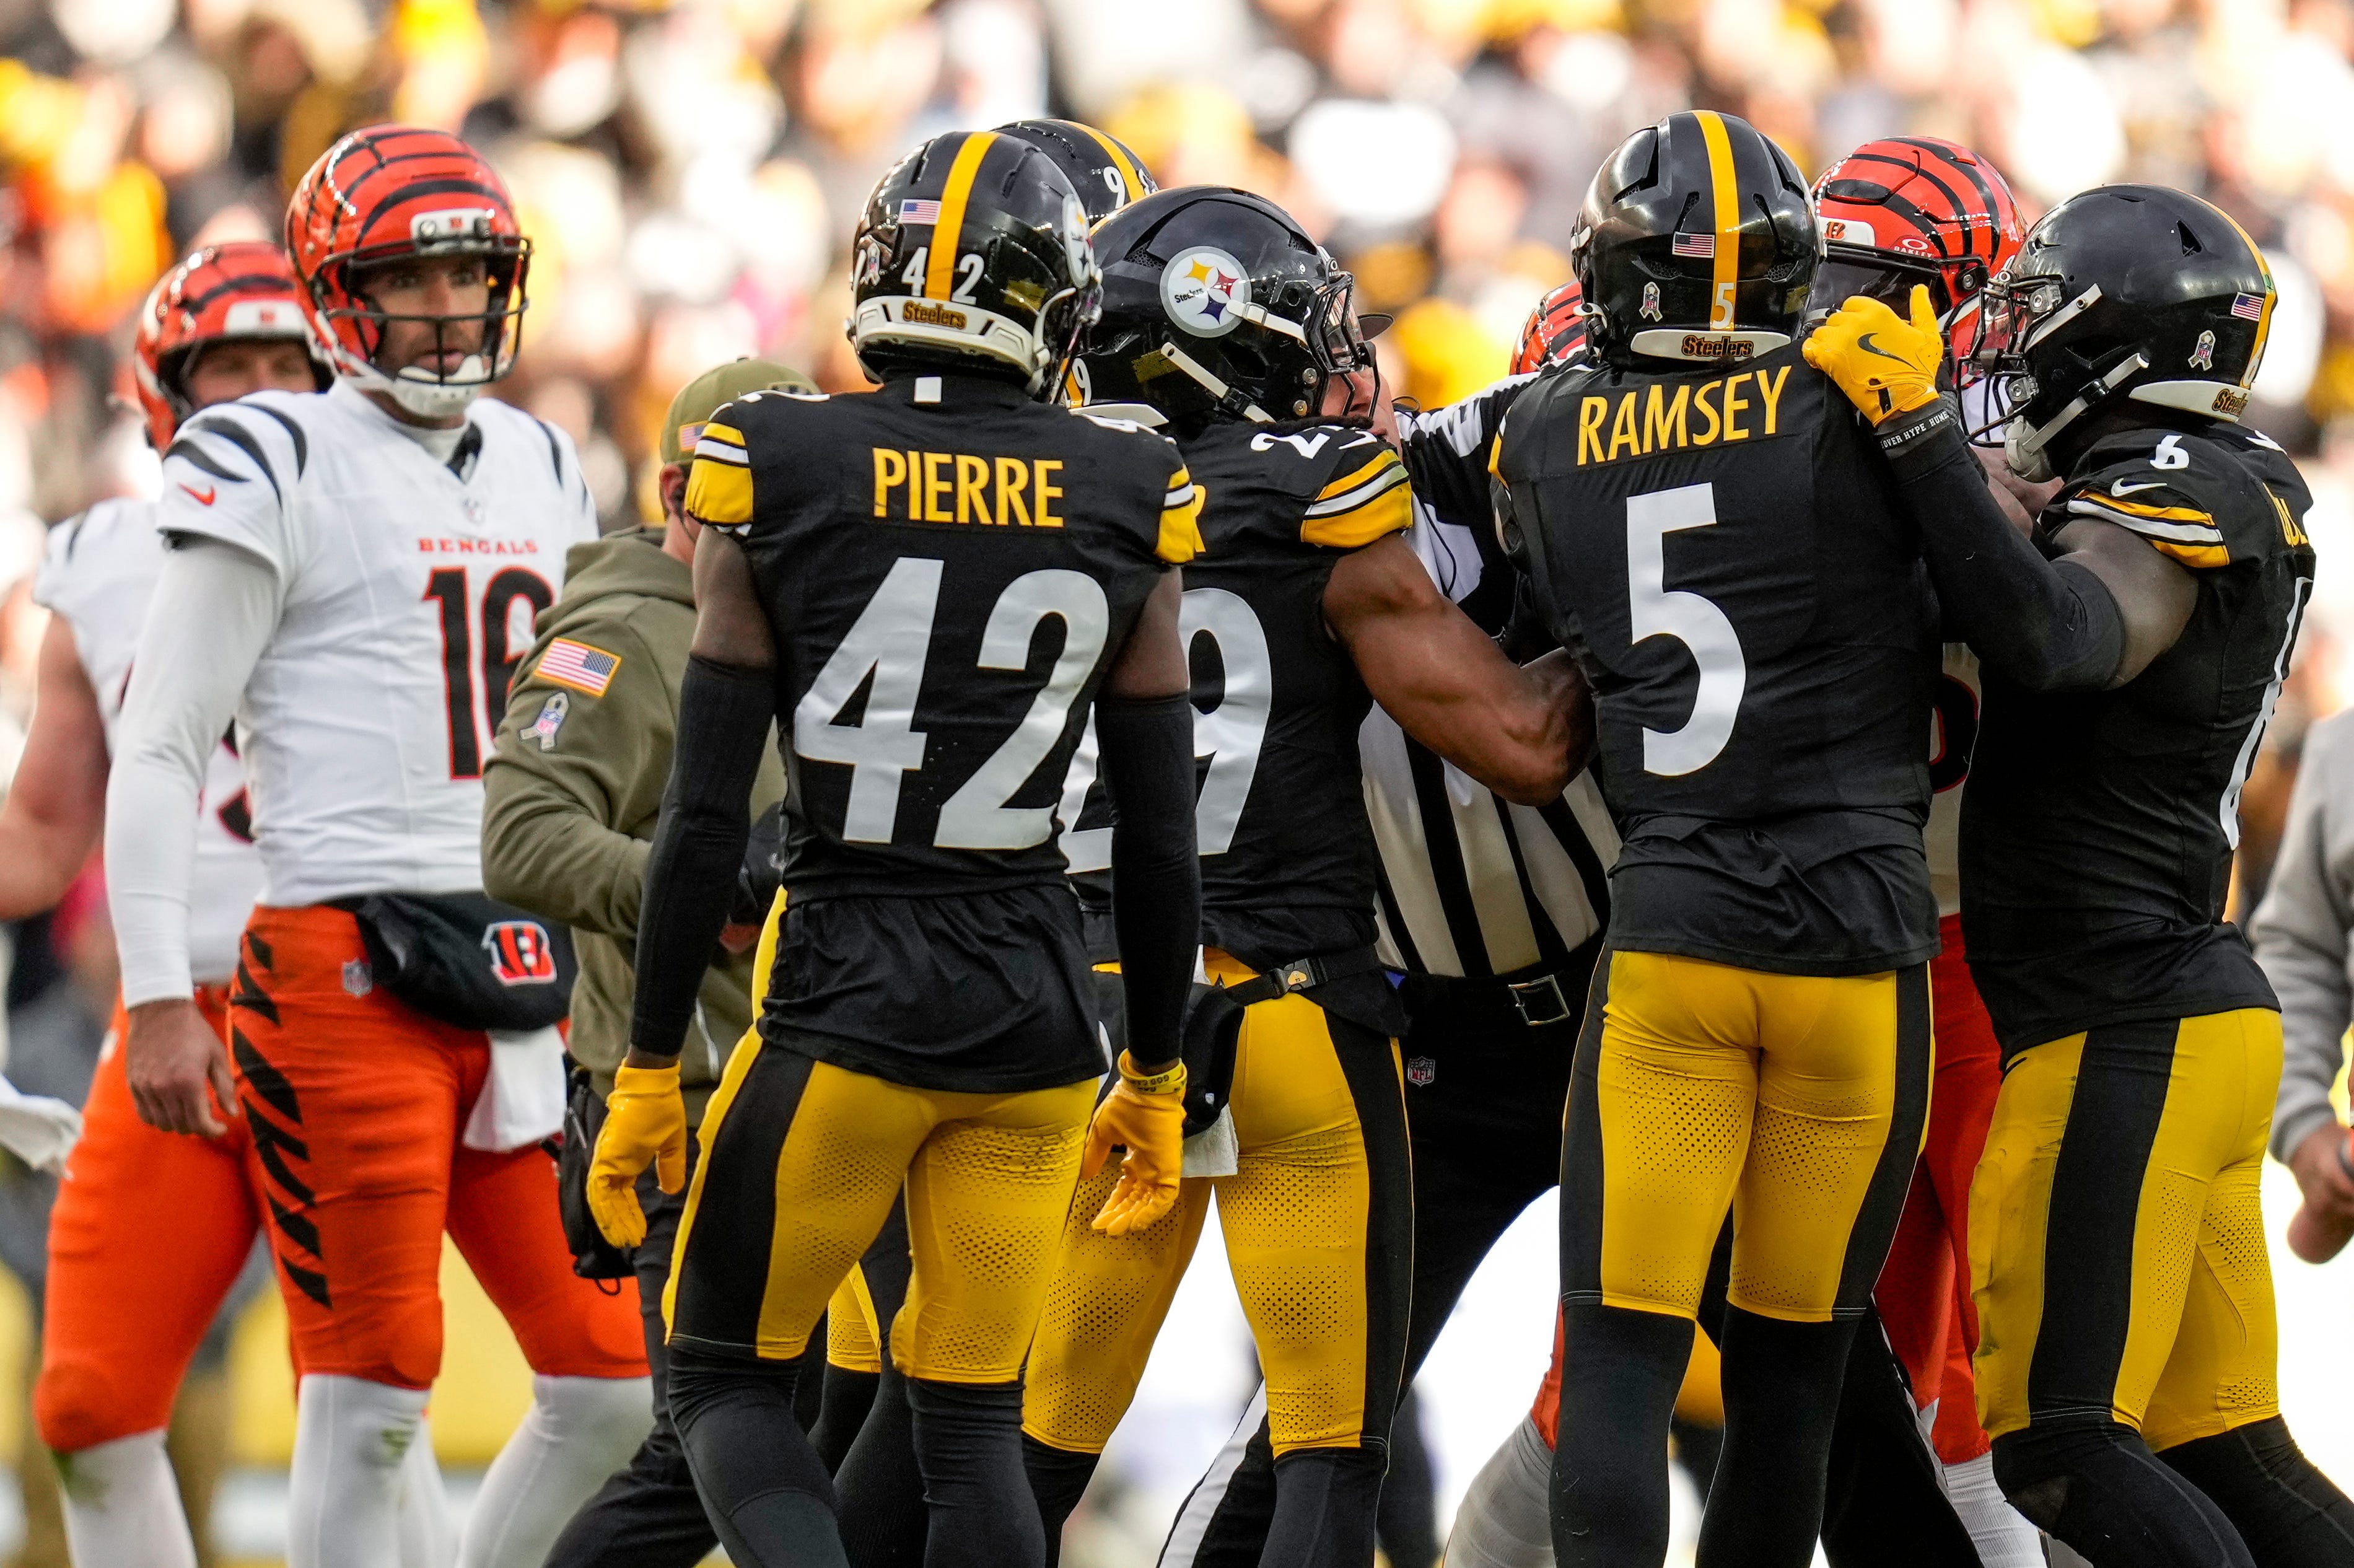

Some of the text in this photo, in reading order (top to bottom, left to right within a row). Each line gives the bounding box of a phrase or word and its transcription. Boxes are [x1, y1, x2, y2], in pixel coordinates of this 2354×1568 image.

[1893, 245, 1934, 259] OAKLEY
[901, 247, 985, 305] 42
[903, 300, 966, 330] Steelers
[1712, 283, 1735, 330] 5
[1682, 335, 1754, 357] Steelers
[1577, 366, 1792, 466] RAMSEY
[1903, 423, 1927, 440] HYPE
[2150, 435, 2189, 470] 6
[873, 447, 1064, 528] PIERRE
[418, 538, 538, 553] BENGALS
[1626, 482, 1746, 777] 5
[794, 556, 1110, 851] 42
